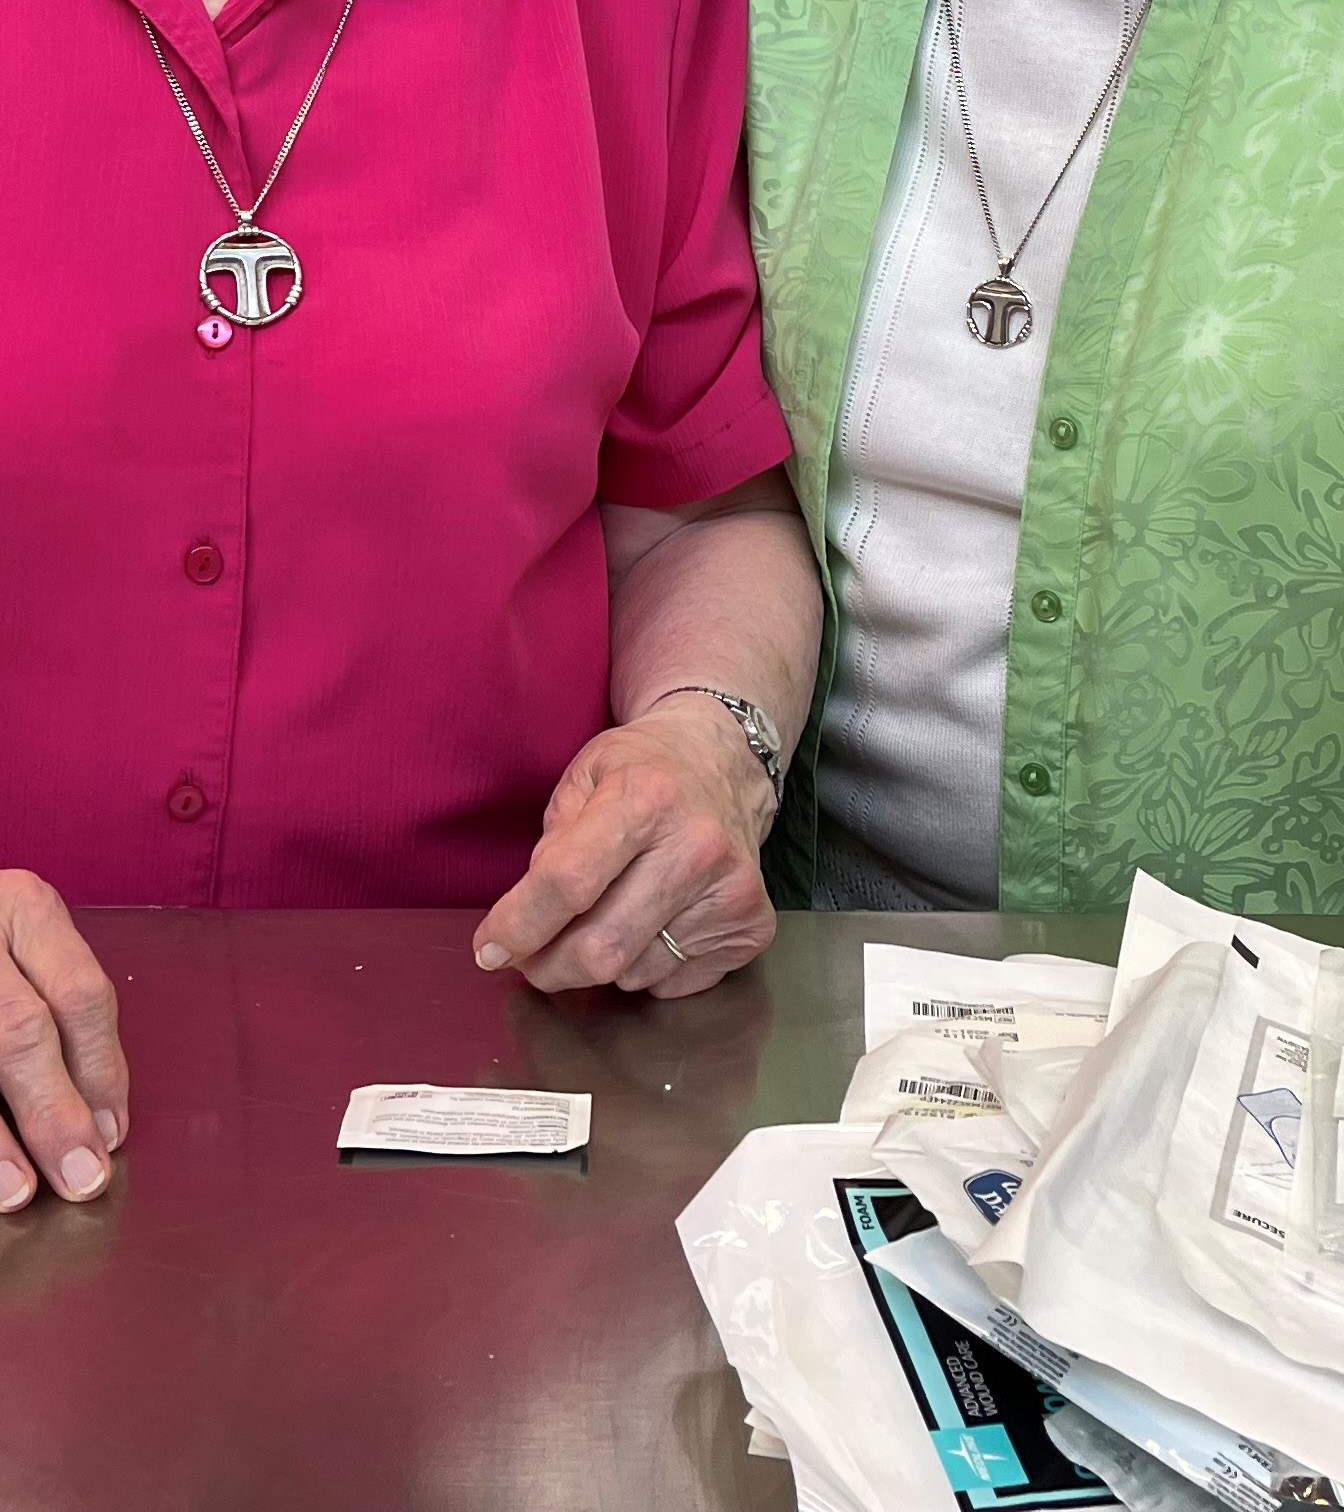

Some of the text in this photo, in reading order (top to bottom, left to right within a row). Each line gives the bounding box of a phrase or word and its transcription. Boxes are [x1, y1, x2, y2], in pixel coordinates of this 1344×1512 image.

[855, 1195, 875, 1231] FOAM
[1233, 1209, 1285, 1238] SECURE
[947, 1355, 982, 1418] ADVANCED
[955, 1340, 998, 1417] WOUND CARE
